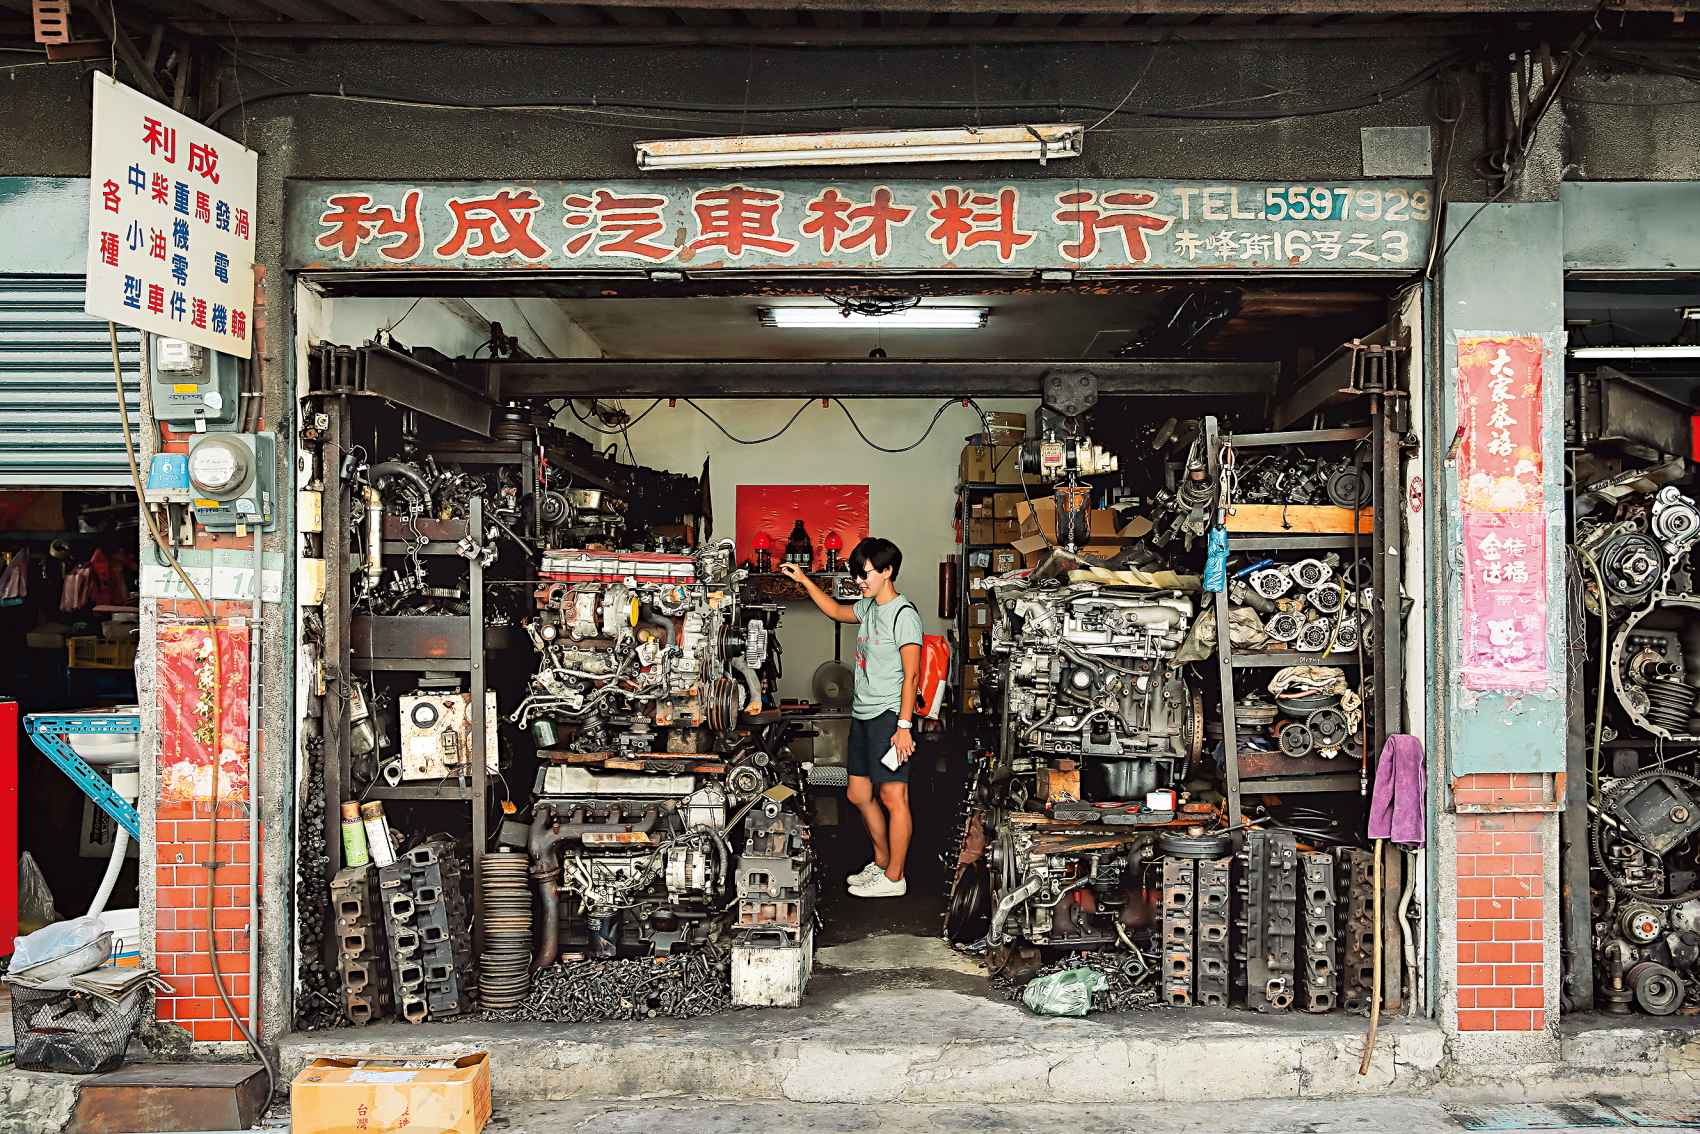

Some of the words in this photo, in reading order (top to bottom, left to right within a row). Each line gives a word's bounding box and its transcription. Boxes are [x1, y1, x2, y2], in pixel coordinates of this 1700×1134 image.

[142, 115, 220, 185] 利成
[99, 178, 121, 268] 各種
[123, 162, 146, 310] 中小型
[147, 171, 169, 315] 柴油車
[169, 180, 190, 322] 重機零件
[191, 190, 211, 330] 馬達
[211, 199, 231, 336] 發電機
[231, 207, 250, 341] 渦輪
[314, 182, 1175, 263] 利成汽車材料行
[1482, 561, 1529, 584] 送福
[356, 1103, 369, 1131] 台灣
